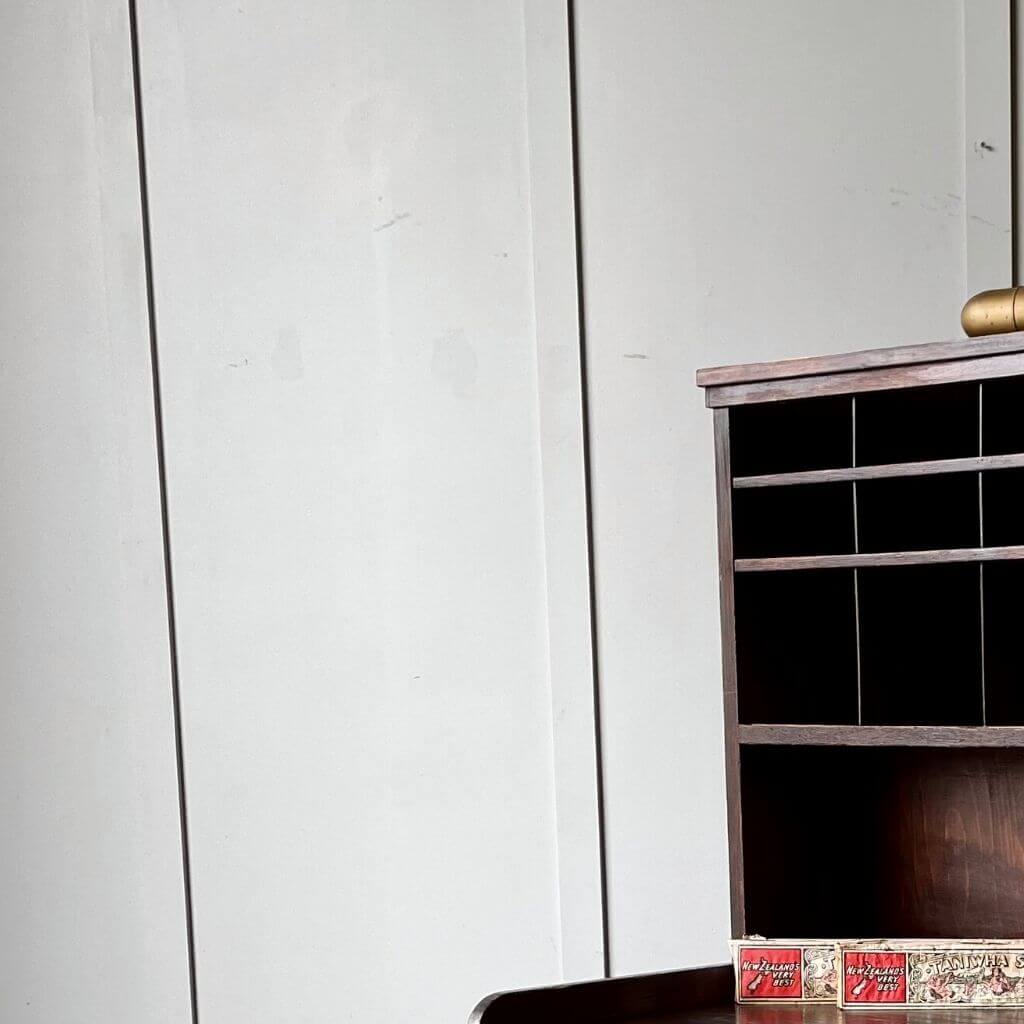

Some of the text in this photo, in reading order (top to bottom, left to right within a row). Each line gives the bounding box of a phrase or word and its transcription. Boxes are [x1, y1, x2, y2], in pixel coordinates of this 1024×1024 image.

[930, 953, 1010, 974] TANIWHA
[772, 971, 794, 979] VERY
[772, 979, 794, 987] BEST
[877, 983, 899, 991] BEST
